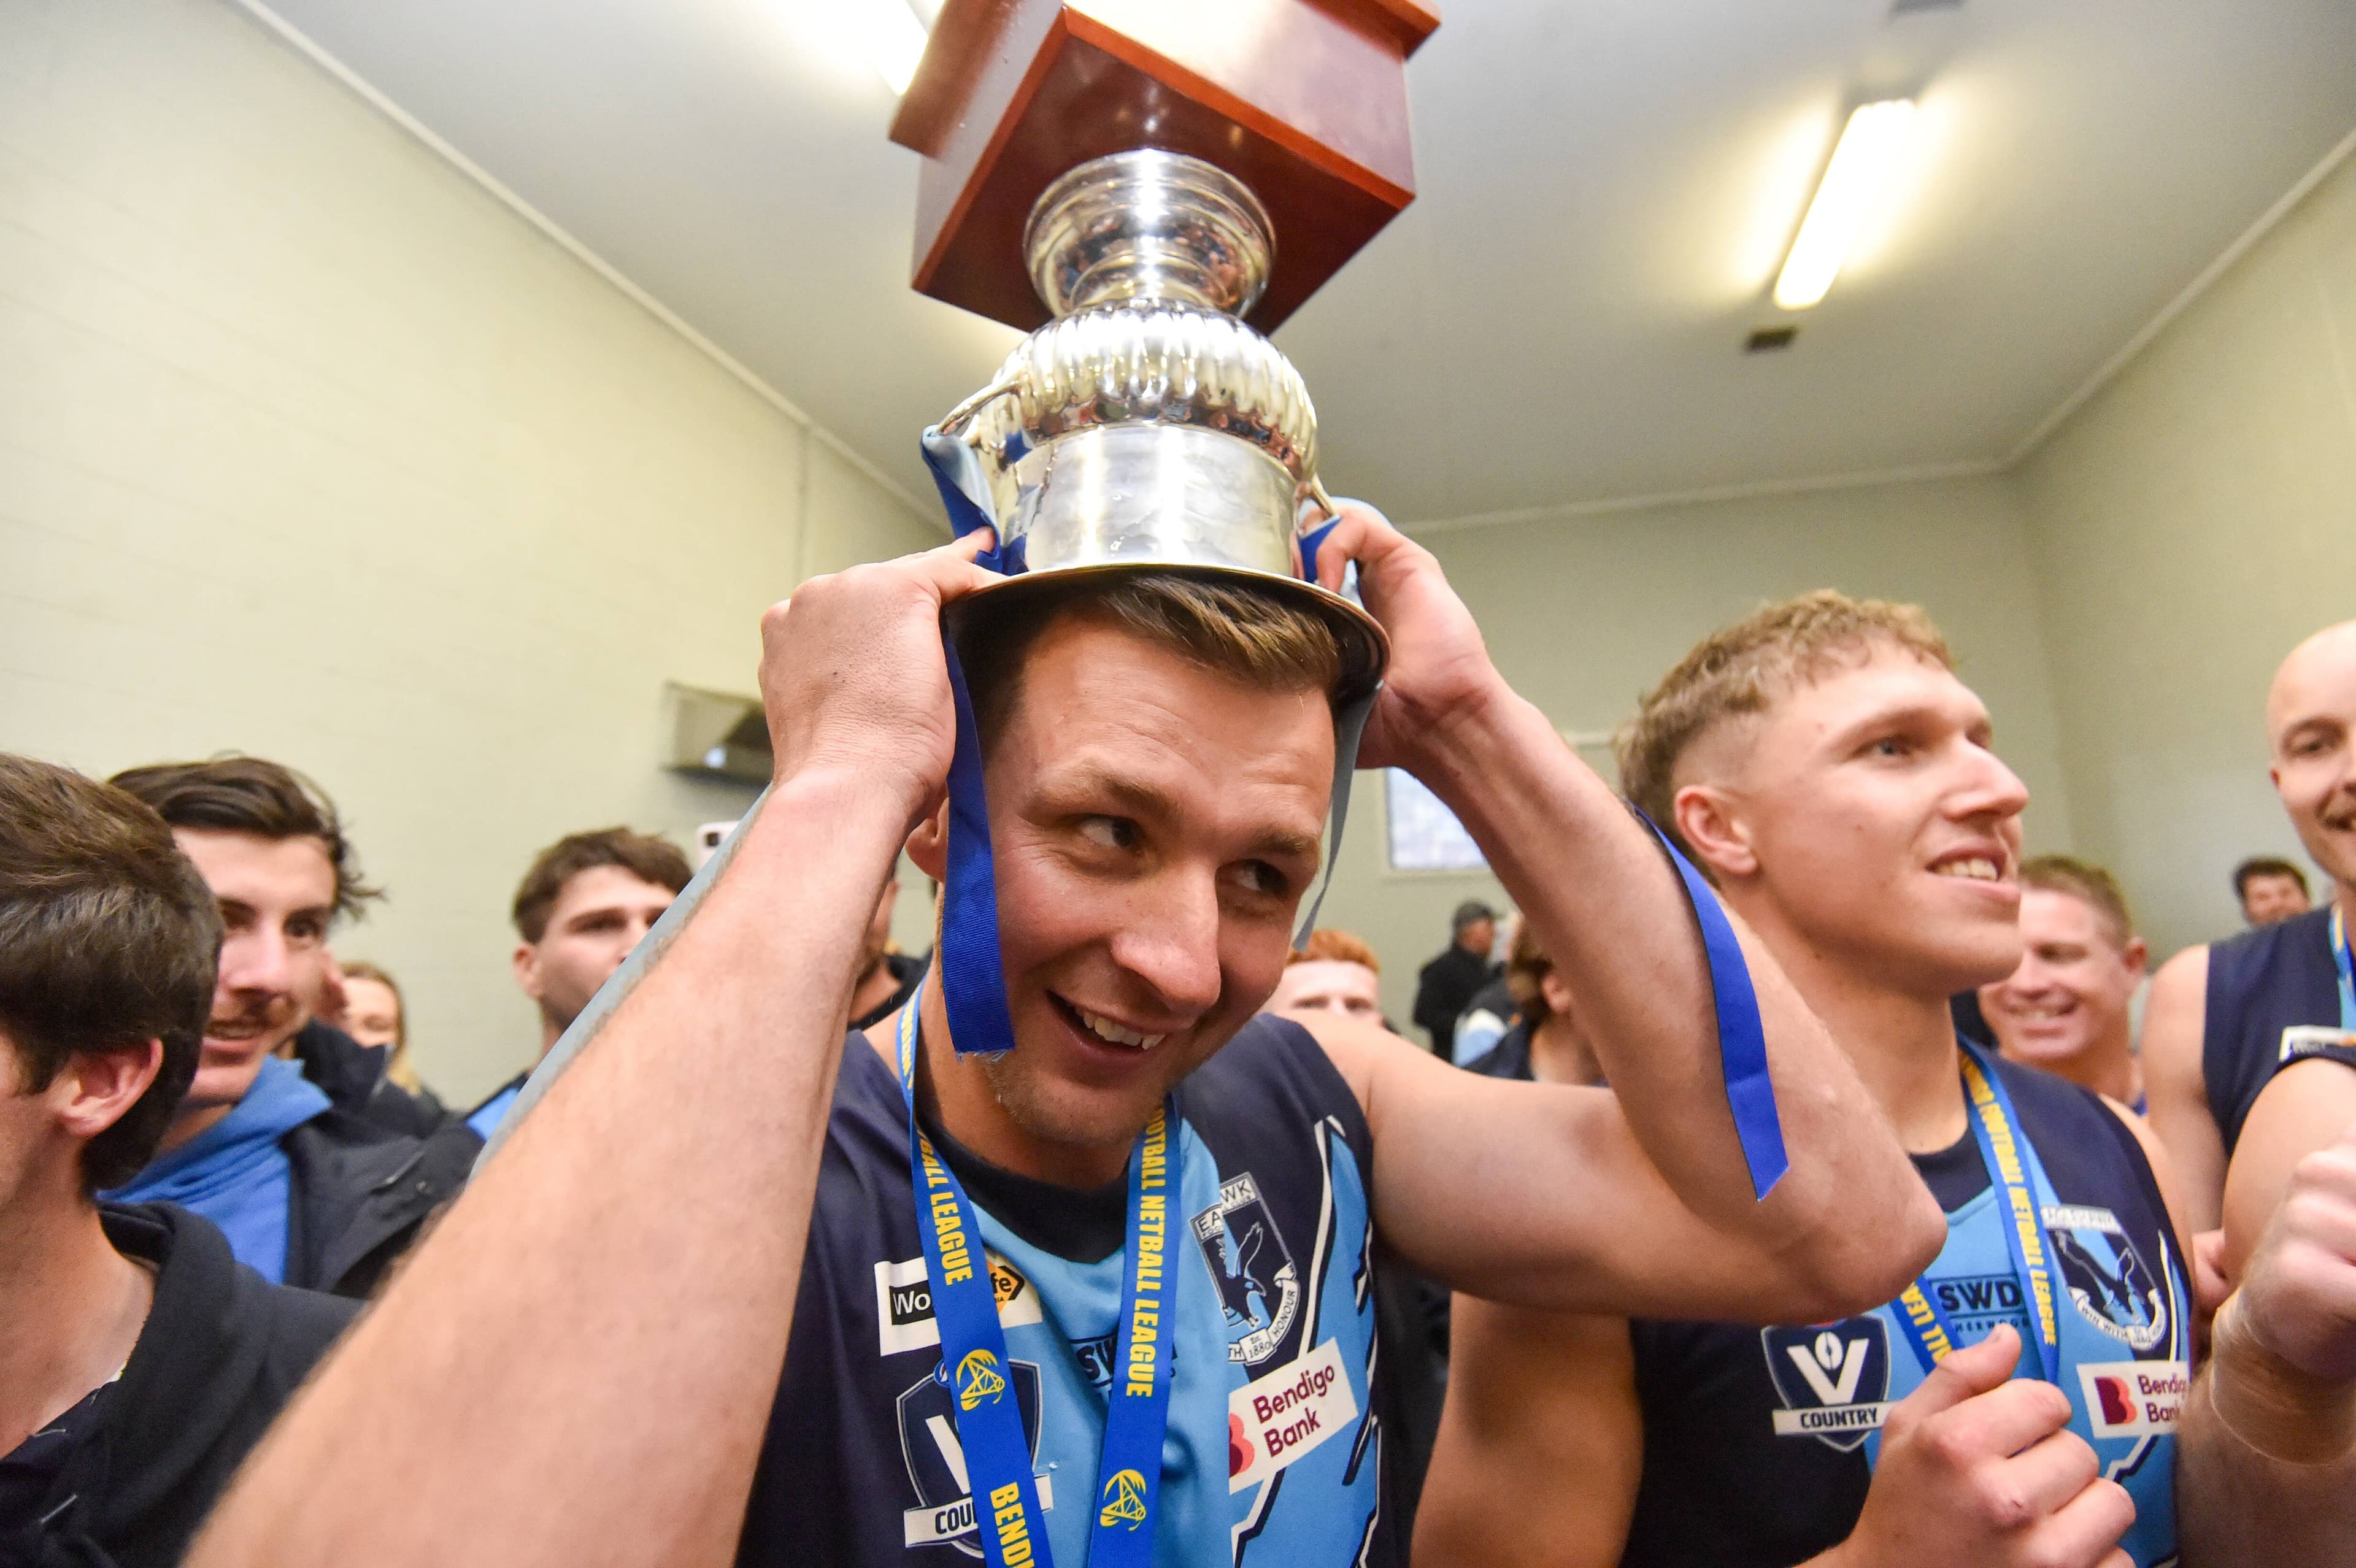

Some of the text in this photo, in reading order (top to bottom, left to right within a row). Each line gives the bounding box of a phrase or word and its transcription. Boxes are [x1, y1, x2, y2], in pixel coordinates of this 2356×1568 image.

[920, 1136, 973, 1286] BALL LEAGUE
[1126, 1107, 1166, 1397] OOTBALL NETBALL LEAGUE
[2008, 1185, 2044, 1266] NETBALL
[2030, 1269, 2057, 1346] LEAGUE
[1272, 1290, 1296, 1338] HONOUR
[1900, 1283, 1935, 1326] LEA
[1937, 1280, 2022, 1312] SWD
[1249, 1341, 1272, 1359] 1880
[1252, 1364, 1335, 1424] Bendigo
[1800, 1407, 1878, 1429] COUNTRY
[2146, 1400, 2180, 1423] Ban
[1264, 1407, 1321, 1458] Bank
